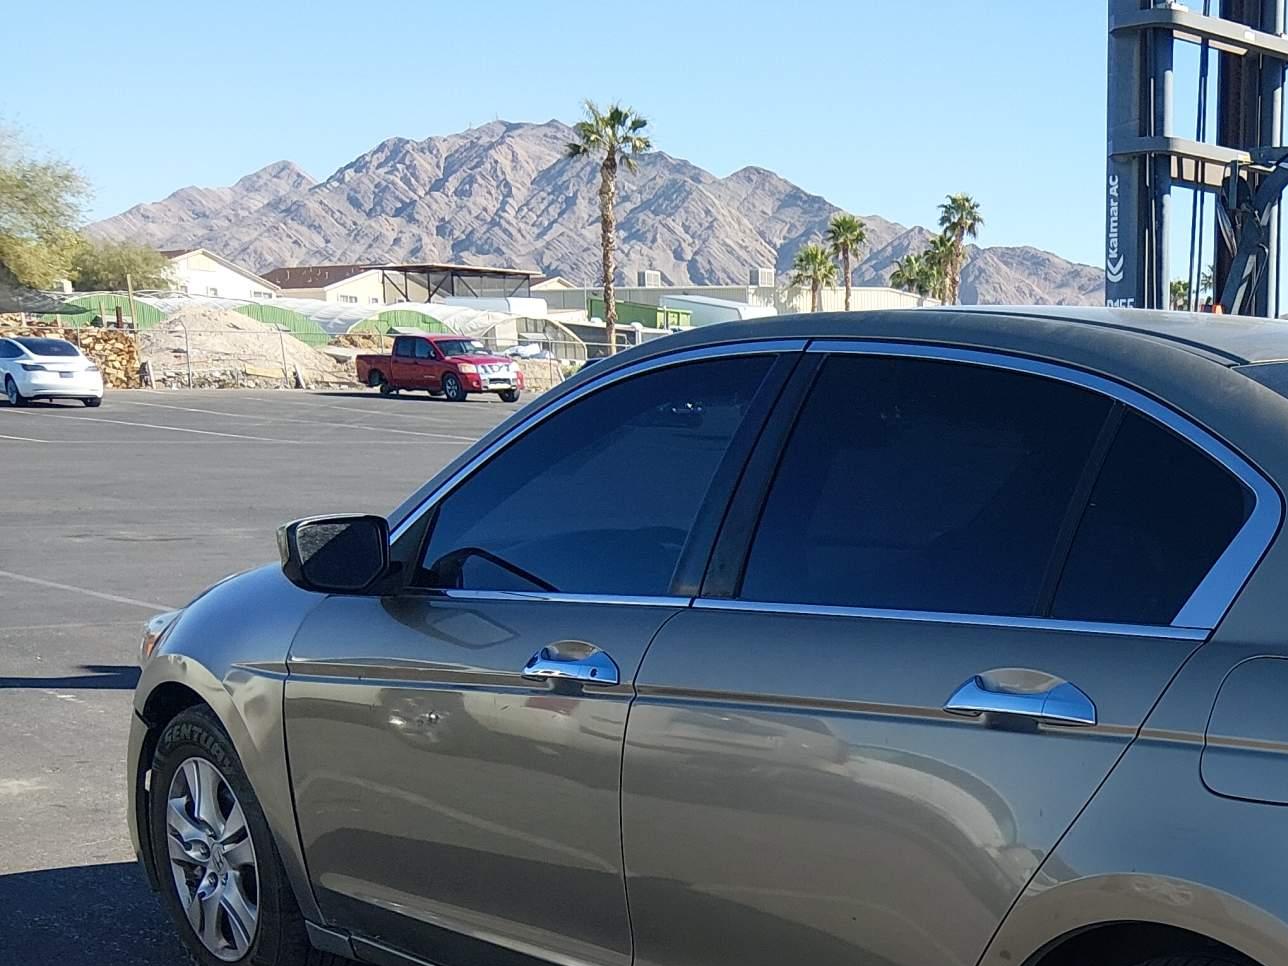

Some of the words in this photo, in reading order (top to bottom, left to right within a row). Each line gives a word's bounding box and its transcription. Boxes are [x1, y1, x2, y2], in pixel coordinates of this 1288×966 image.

[1108, 175, 1119, 197] AC
[1108, 199, 1119, 258] Kalmar
[164, 722, 234, 774] SENTURY
